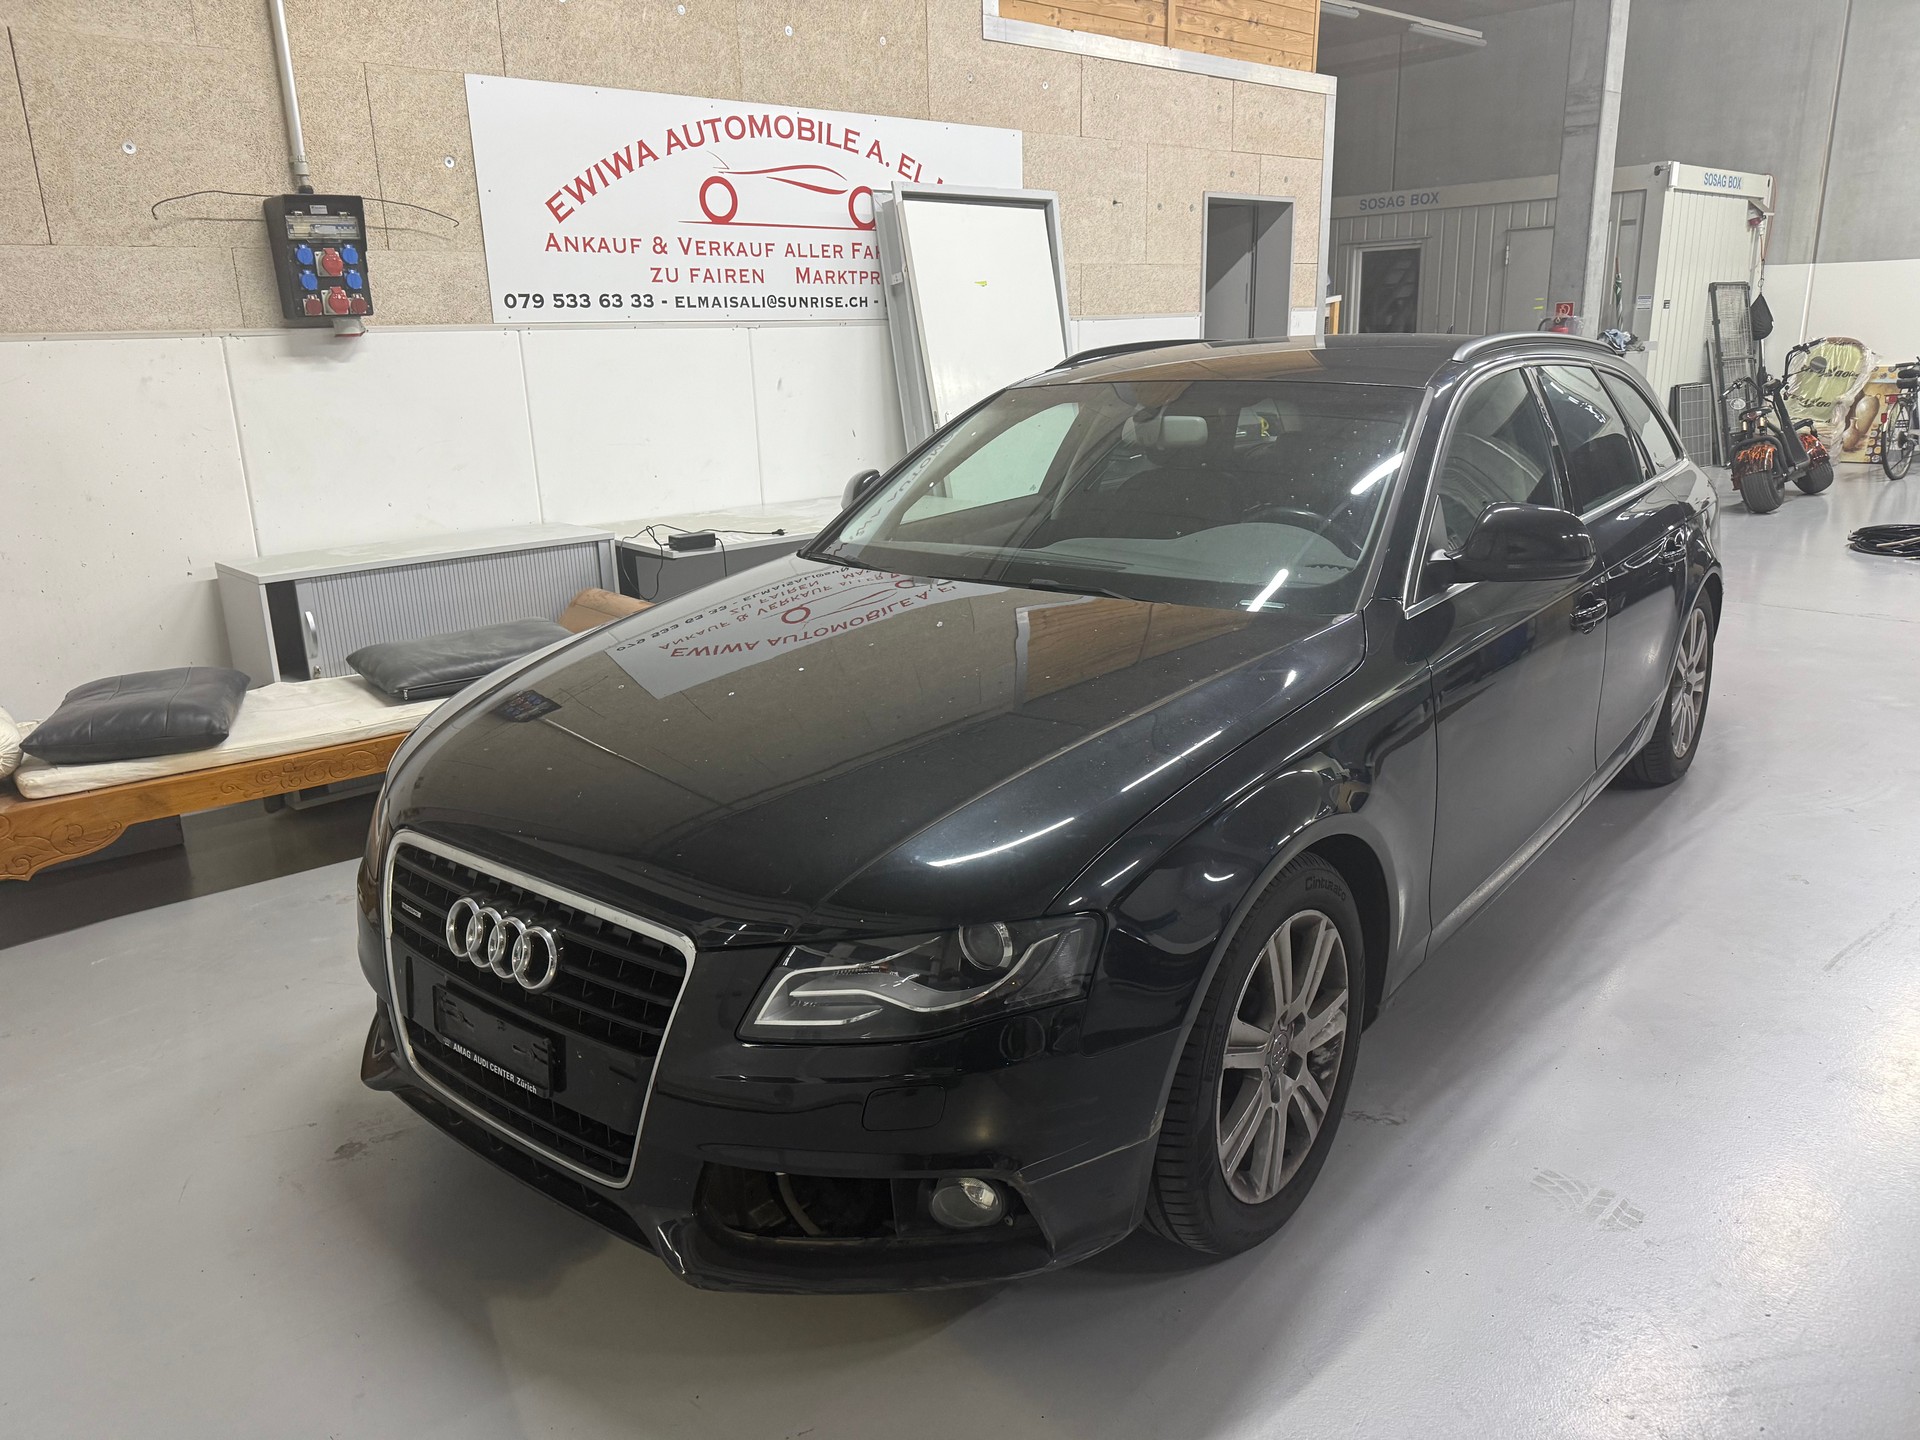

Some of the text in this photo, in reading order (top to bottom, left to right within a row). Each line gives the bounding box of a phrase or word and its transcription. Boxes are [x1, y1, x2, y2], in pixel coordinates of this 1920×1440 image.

[544, 139, 660, 224] EWIWA
[666, 114, 860, 156] AUTOMOBILE
[866, 139, 890, 167] A.
[1703, 172, 1742, 190] SOSAG BOX
[1360, 192, 1439, 211] SOSAG BOX
[545, 232, 642, 254] ANKAUF
[652, 236, 668, 255] &
[677, 236, 775, 258] VERKAUF
[784, 242, 843, 259] ALLER
[650, 267, 679, 283] ZU
[690, 267, 765, 284] FAIREN
[503, 293, 545, 309] 079
[553, 293, 591, 309] 533
[599, 293, 623, 309] 63
[630, 293, 655, 309] 33
[675, 294, 869, 308] ELMAISALI@SUNRISE.CH
[453, 1043, 537, 1094] AMAG AUDI CENTER Zürich
